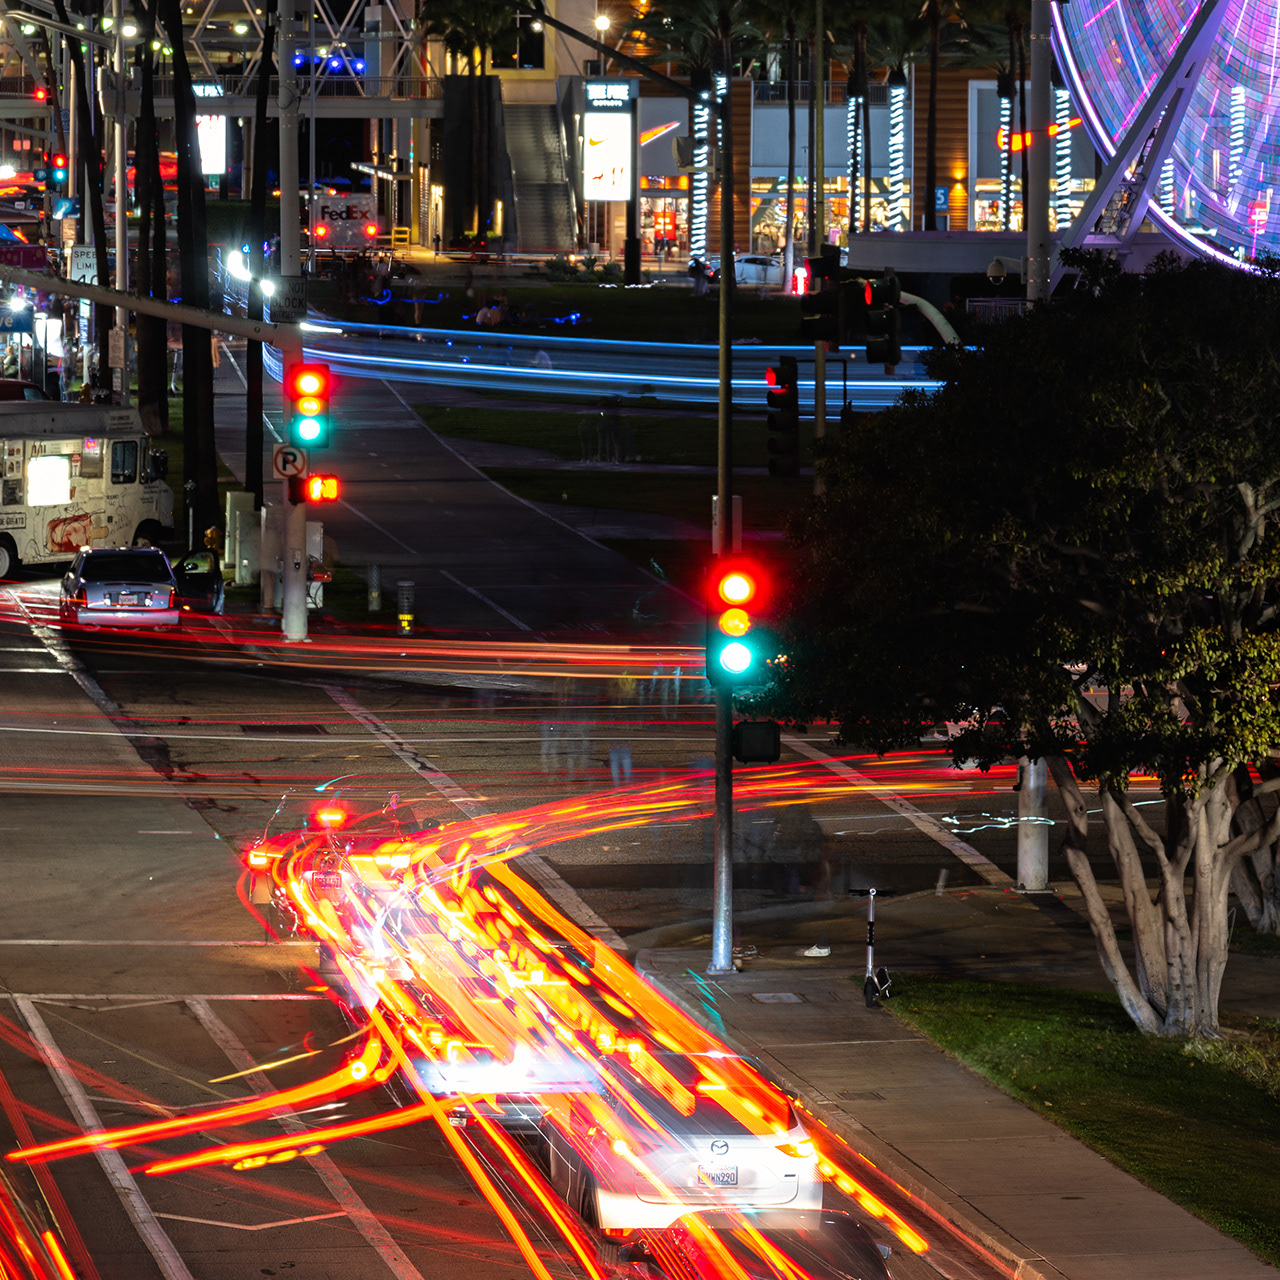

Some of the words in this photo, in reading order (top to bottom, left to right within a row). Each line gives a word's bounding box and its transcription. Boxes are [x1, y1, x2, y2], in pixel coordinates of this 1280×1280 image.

[587, 84, 606, 100] THE
[607, 84, 629, 100] PIKE
[321, 205, 370, 220] FedEx
[74, 250, 96, 259] SPEE
[77, 262, 96, 270] LIMI
[289, 282, 304, 293] NOT
